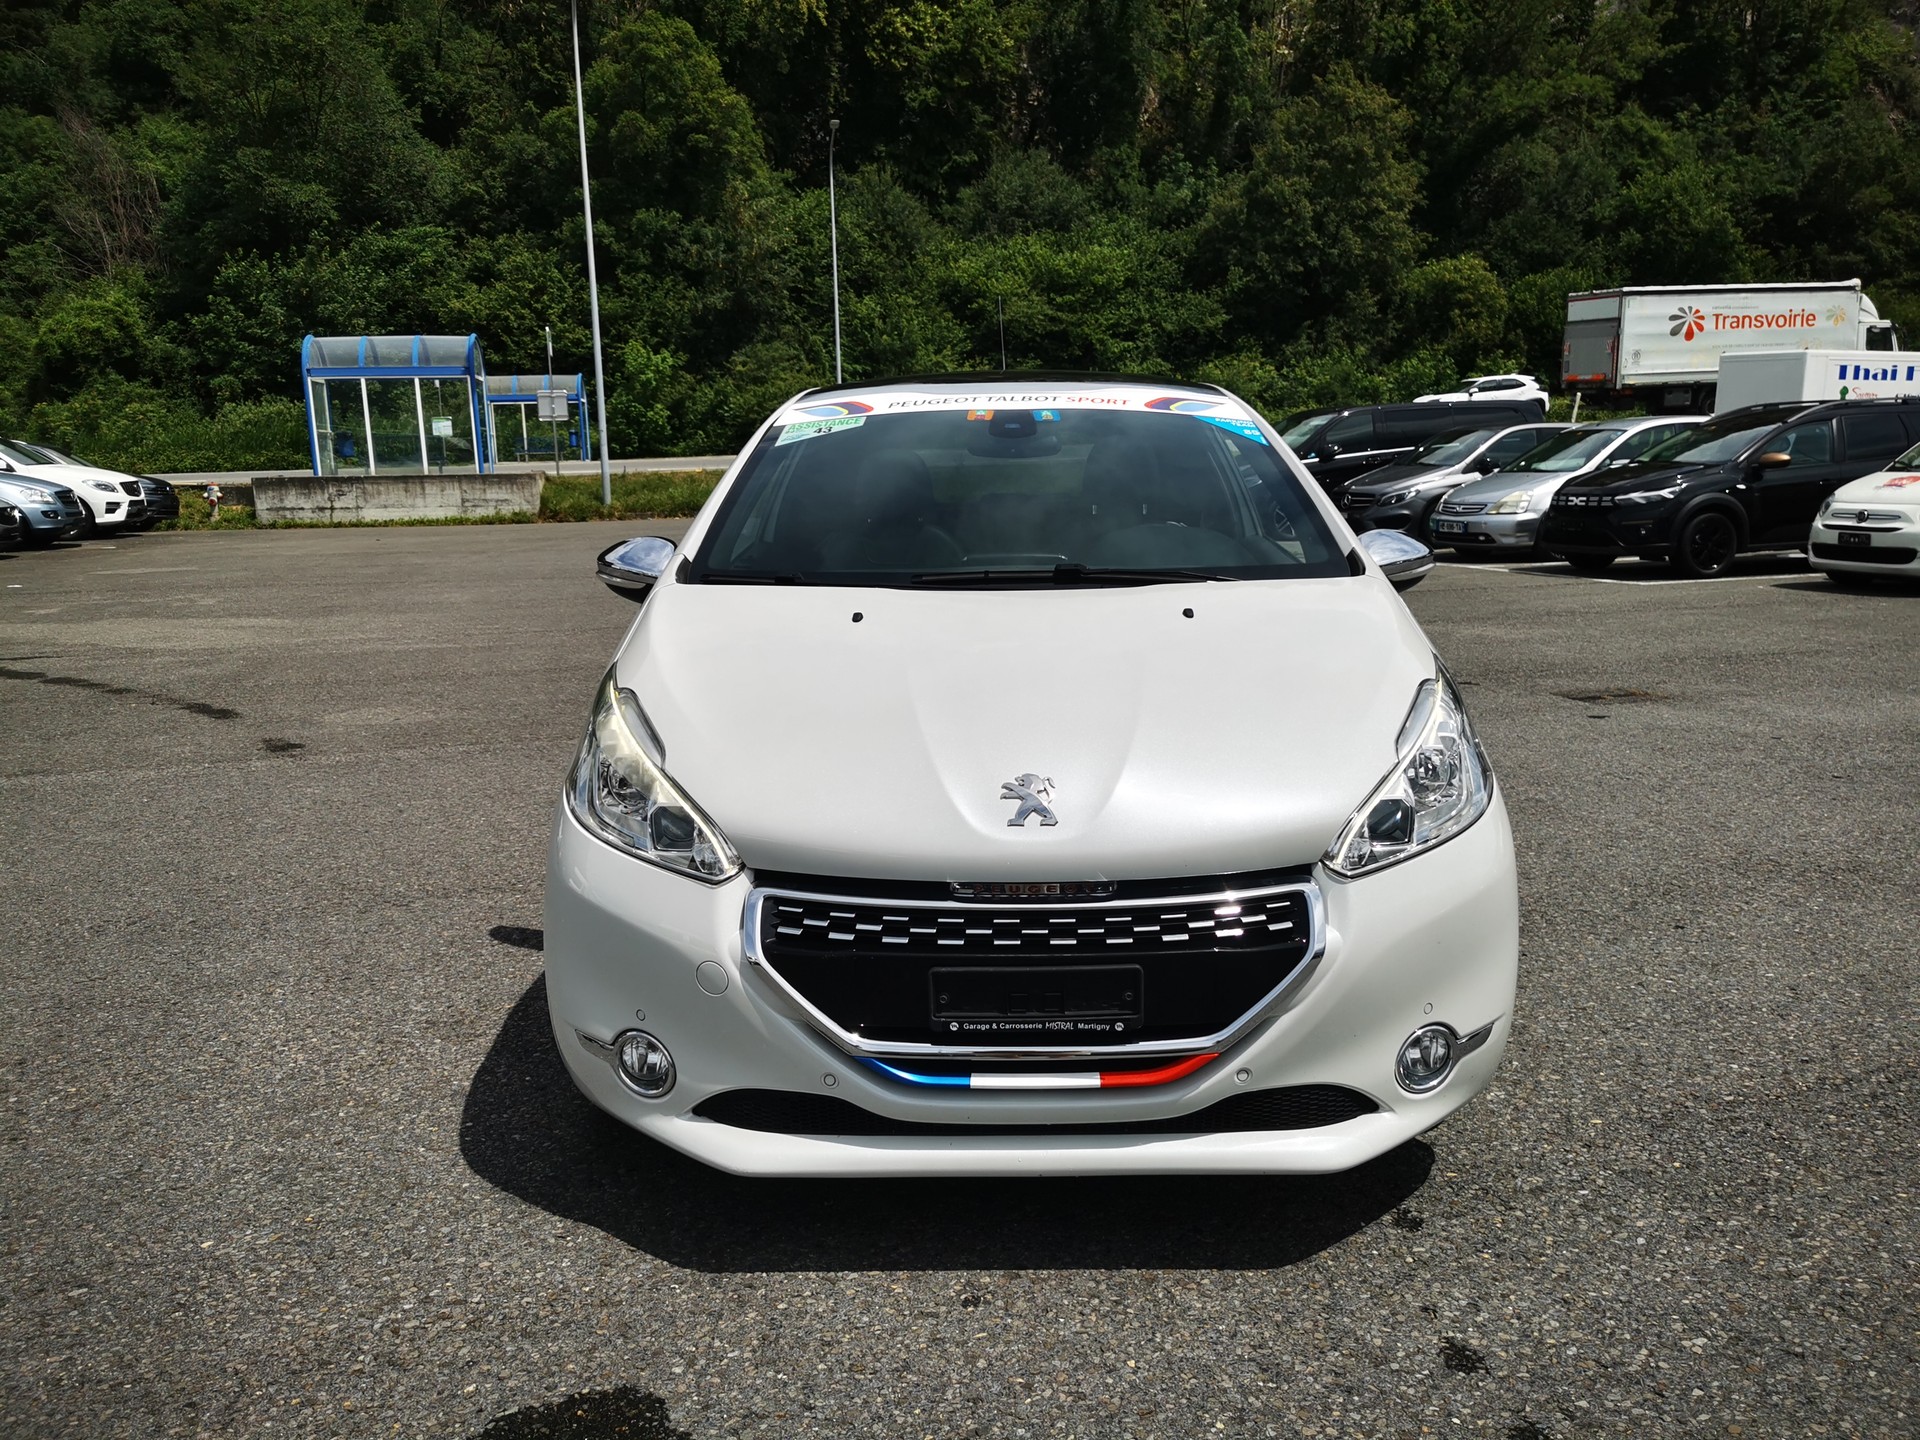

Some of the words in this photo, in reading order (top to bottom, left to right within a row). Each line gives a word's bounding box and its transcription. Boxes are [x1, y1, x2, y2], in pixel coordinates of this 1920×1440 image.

[1712, 308, 1817, 330] Transvoirie
[1835, 364, 1898, 381] Thai
[888, 396, 983, 409] PEUGEOT
[985, 395, 1061, 403] TALBOT
[1066, 396, 1131, 406] SPORT
[788, 417, 861, 431] ASSISTANCE
[813, 426, 833, 434] 43
[973, 884, 1095, 894] PEUGEOT
[963, 1022, 990, 1030] Garage
[1045, 1021, 1075, 1031] MISTRAL
[1078, 1022, 1111, 1031] Martigny
